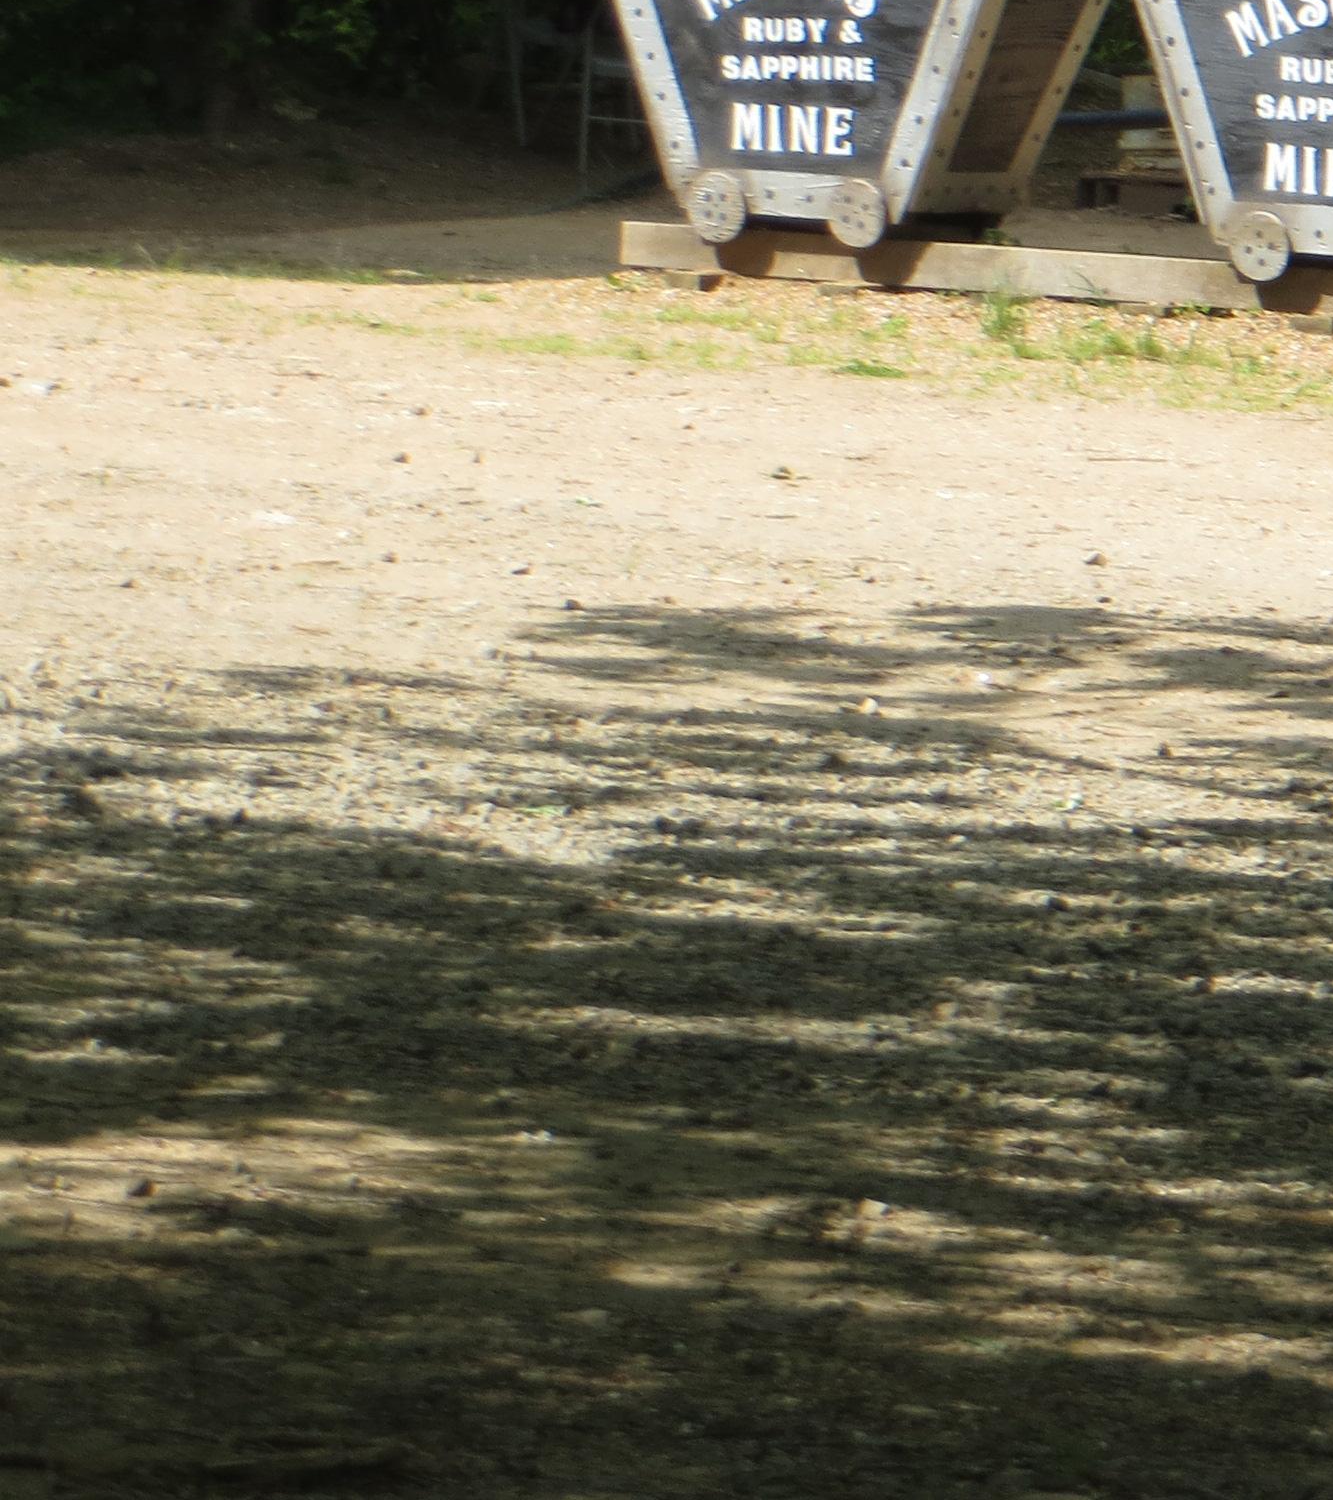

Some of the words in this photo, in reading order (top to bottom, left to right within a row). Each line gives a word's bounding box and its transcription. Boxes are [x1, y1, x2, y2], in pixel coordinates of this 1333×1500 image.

[742, 17, 828, 43] RUBY
[839, 19, 863, 44] &
[720, 54, 875, 82] SAPPHIRE
[731, 102, 854, 156] MINE
